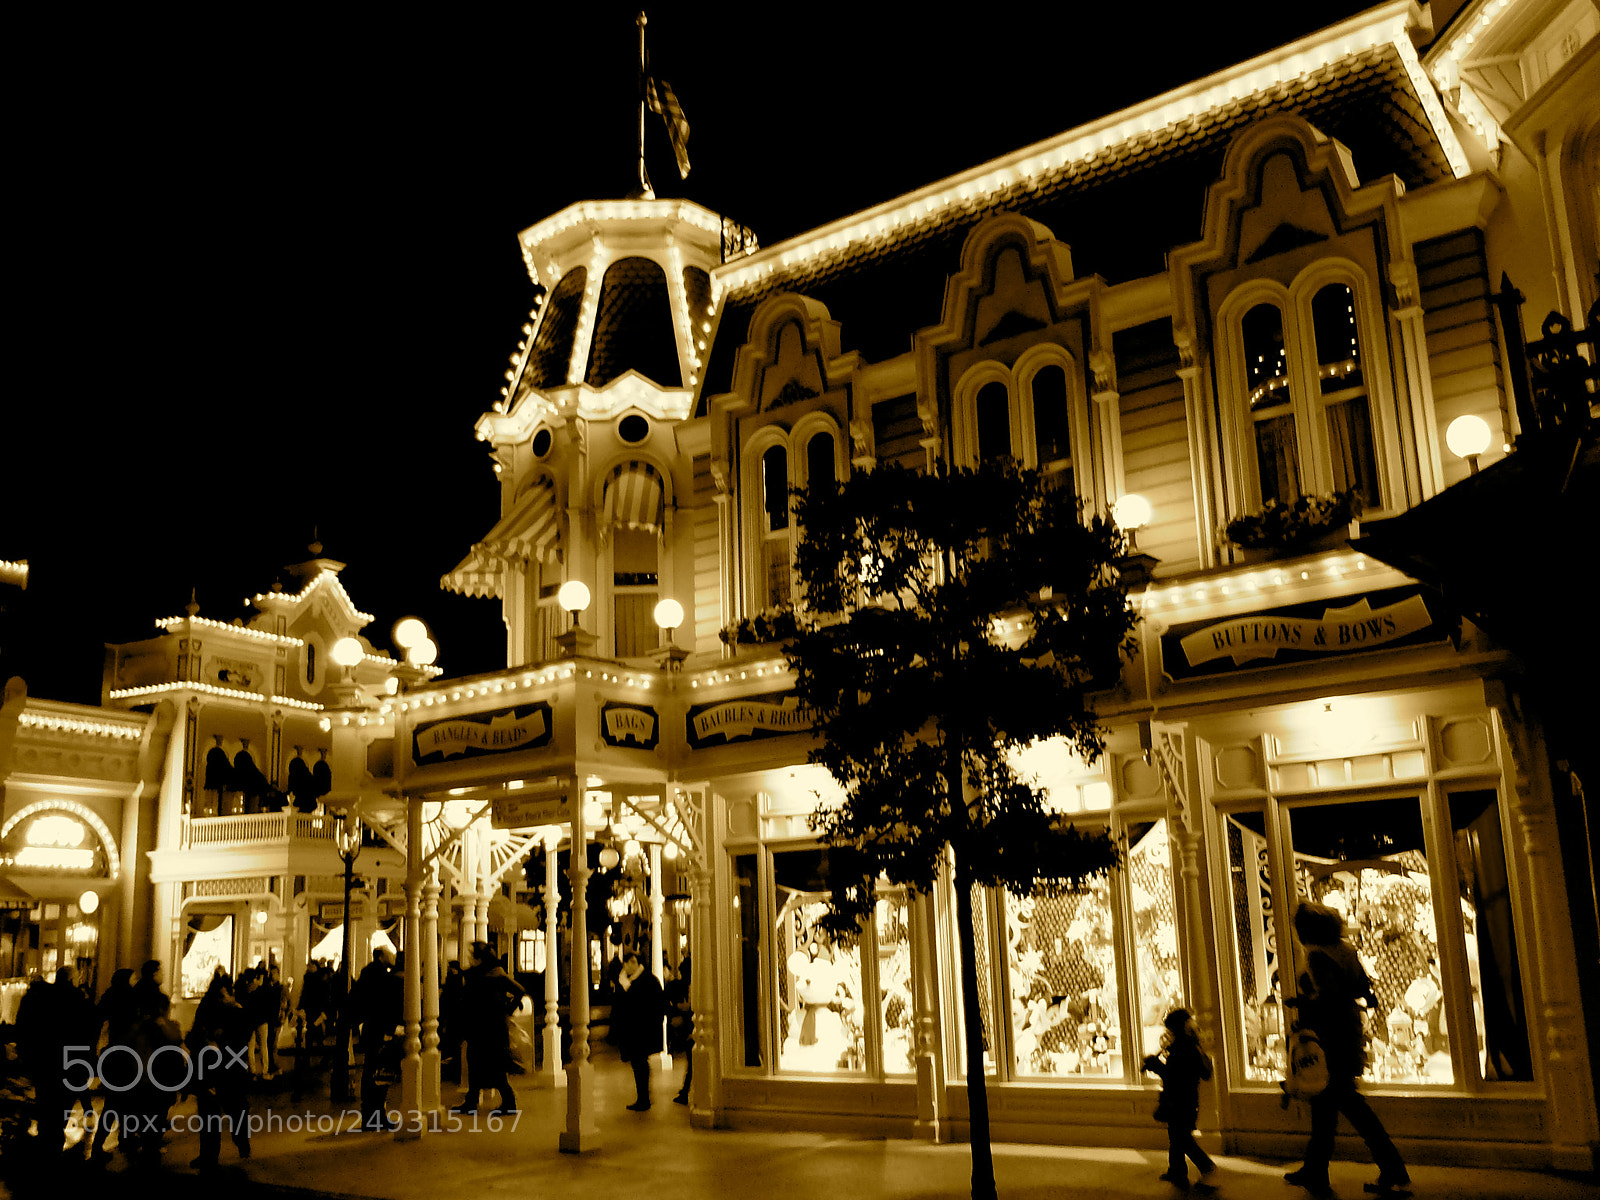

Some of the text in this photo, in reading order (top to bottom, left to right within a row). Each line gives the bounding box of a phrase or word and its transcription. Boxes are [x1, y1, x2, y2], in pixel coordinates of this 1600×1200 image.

[1212, 614, 1397, 649] BUTTONS & BOWS
[616, 712, 645, 730] BAGS
[702, 704, 754, 732] BAUBLES
[757, 710, 764, 722] &
[434, 725, 527, 745] BANGLES & BEADS
